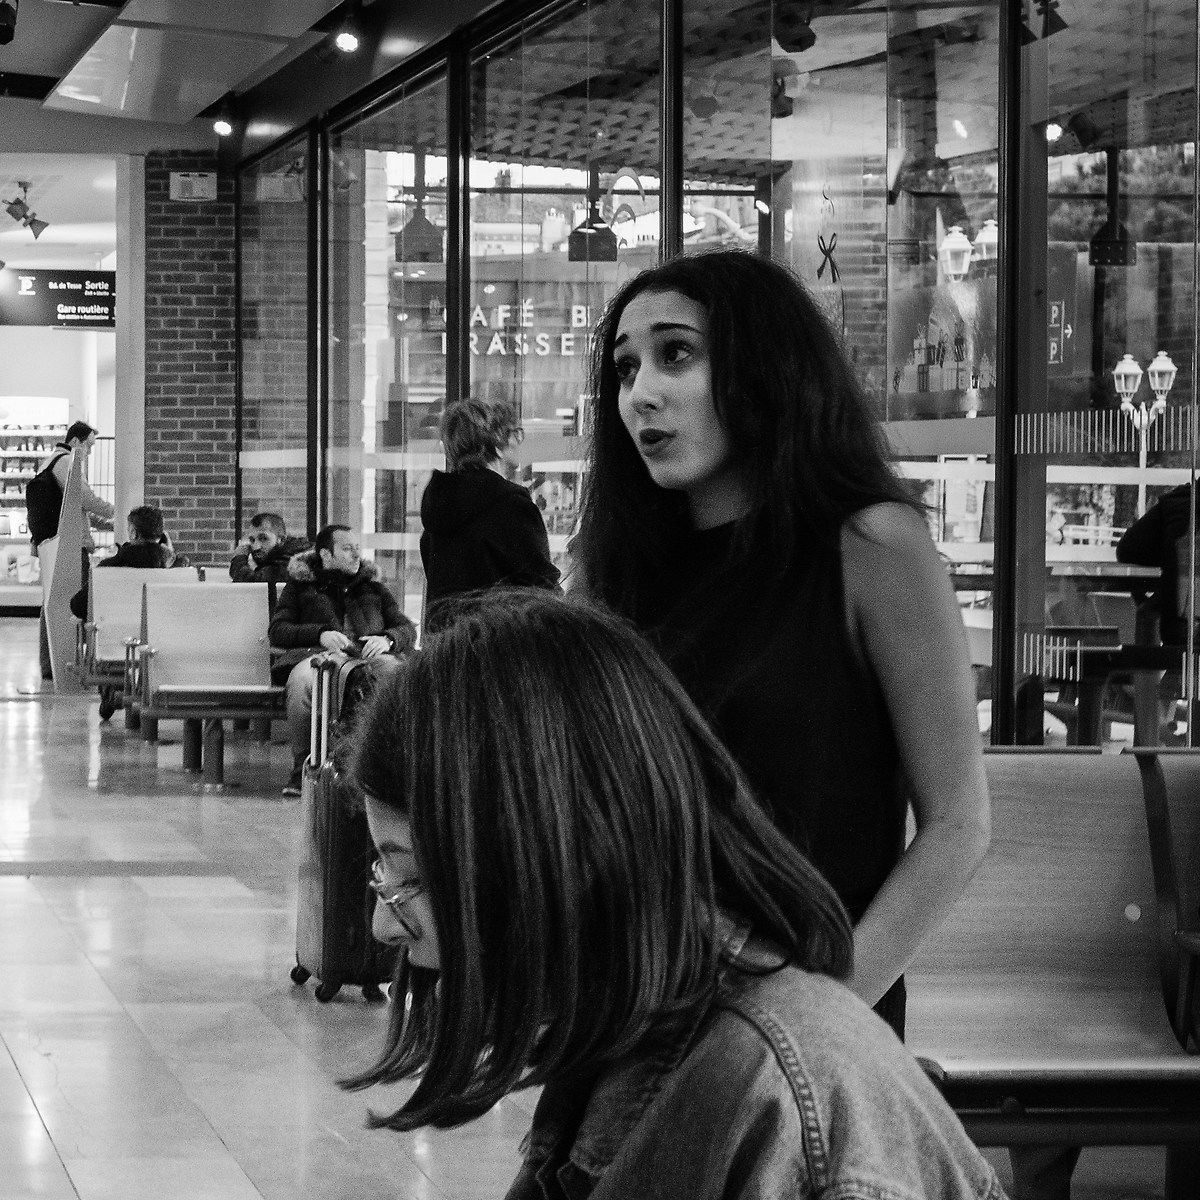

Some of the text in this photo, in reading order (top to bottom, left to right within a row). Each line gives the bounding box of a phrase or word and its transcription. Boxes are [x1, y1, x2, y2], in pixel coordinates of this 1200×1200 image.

[85, 280, 110, 290] Sortie
[57, 303, 110, 314] Gare routière
[443, 298, 535, 328] AFÉ
